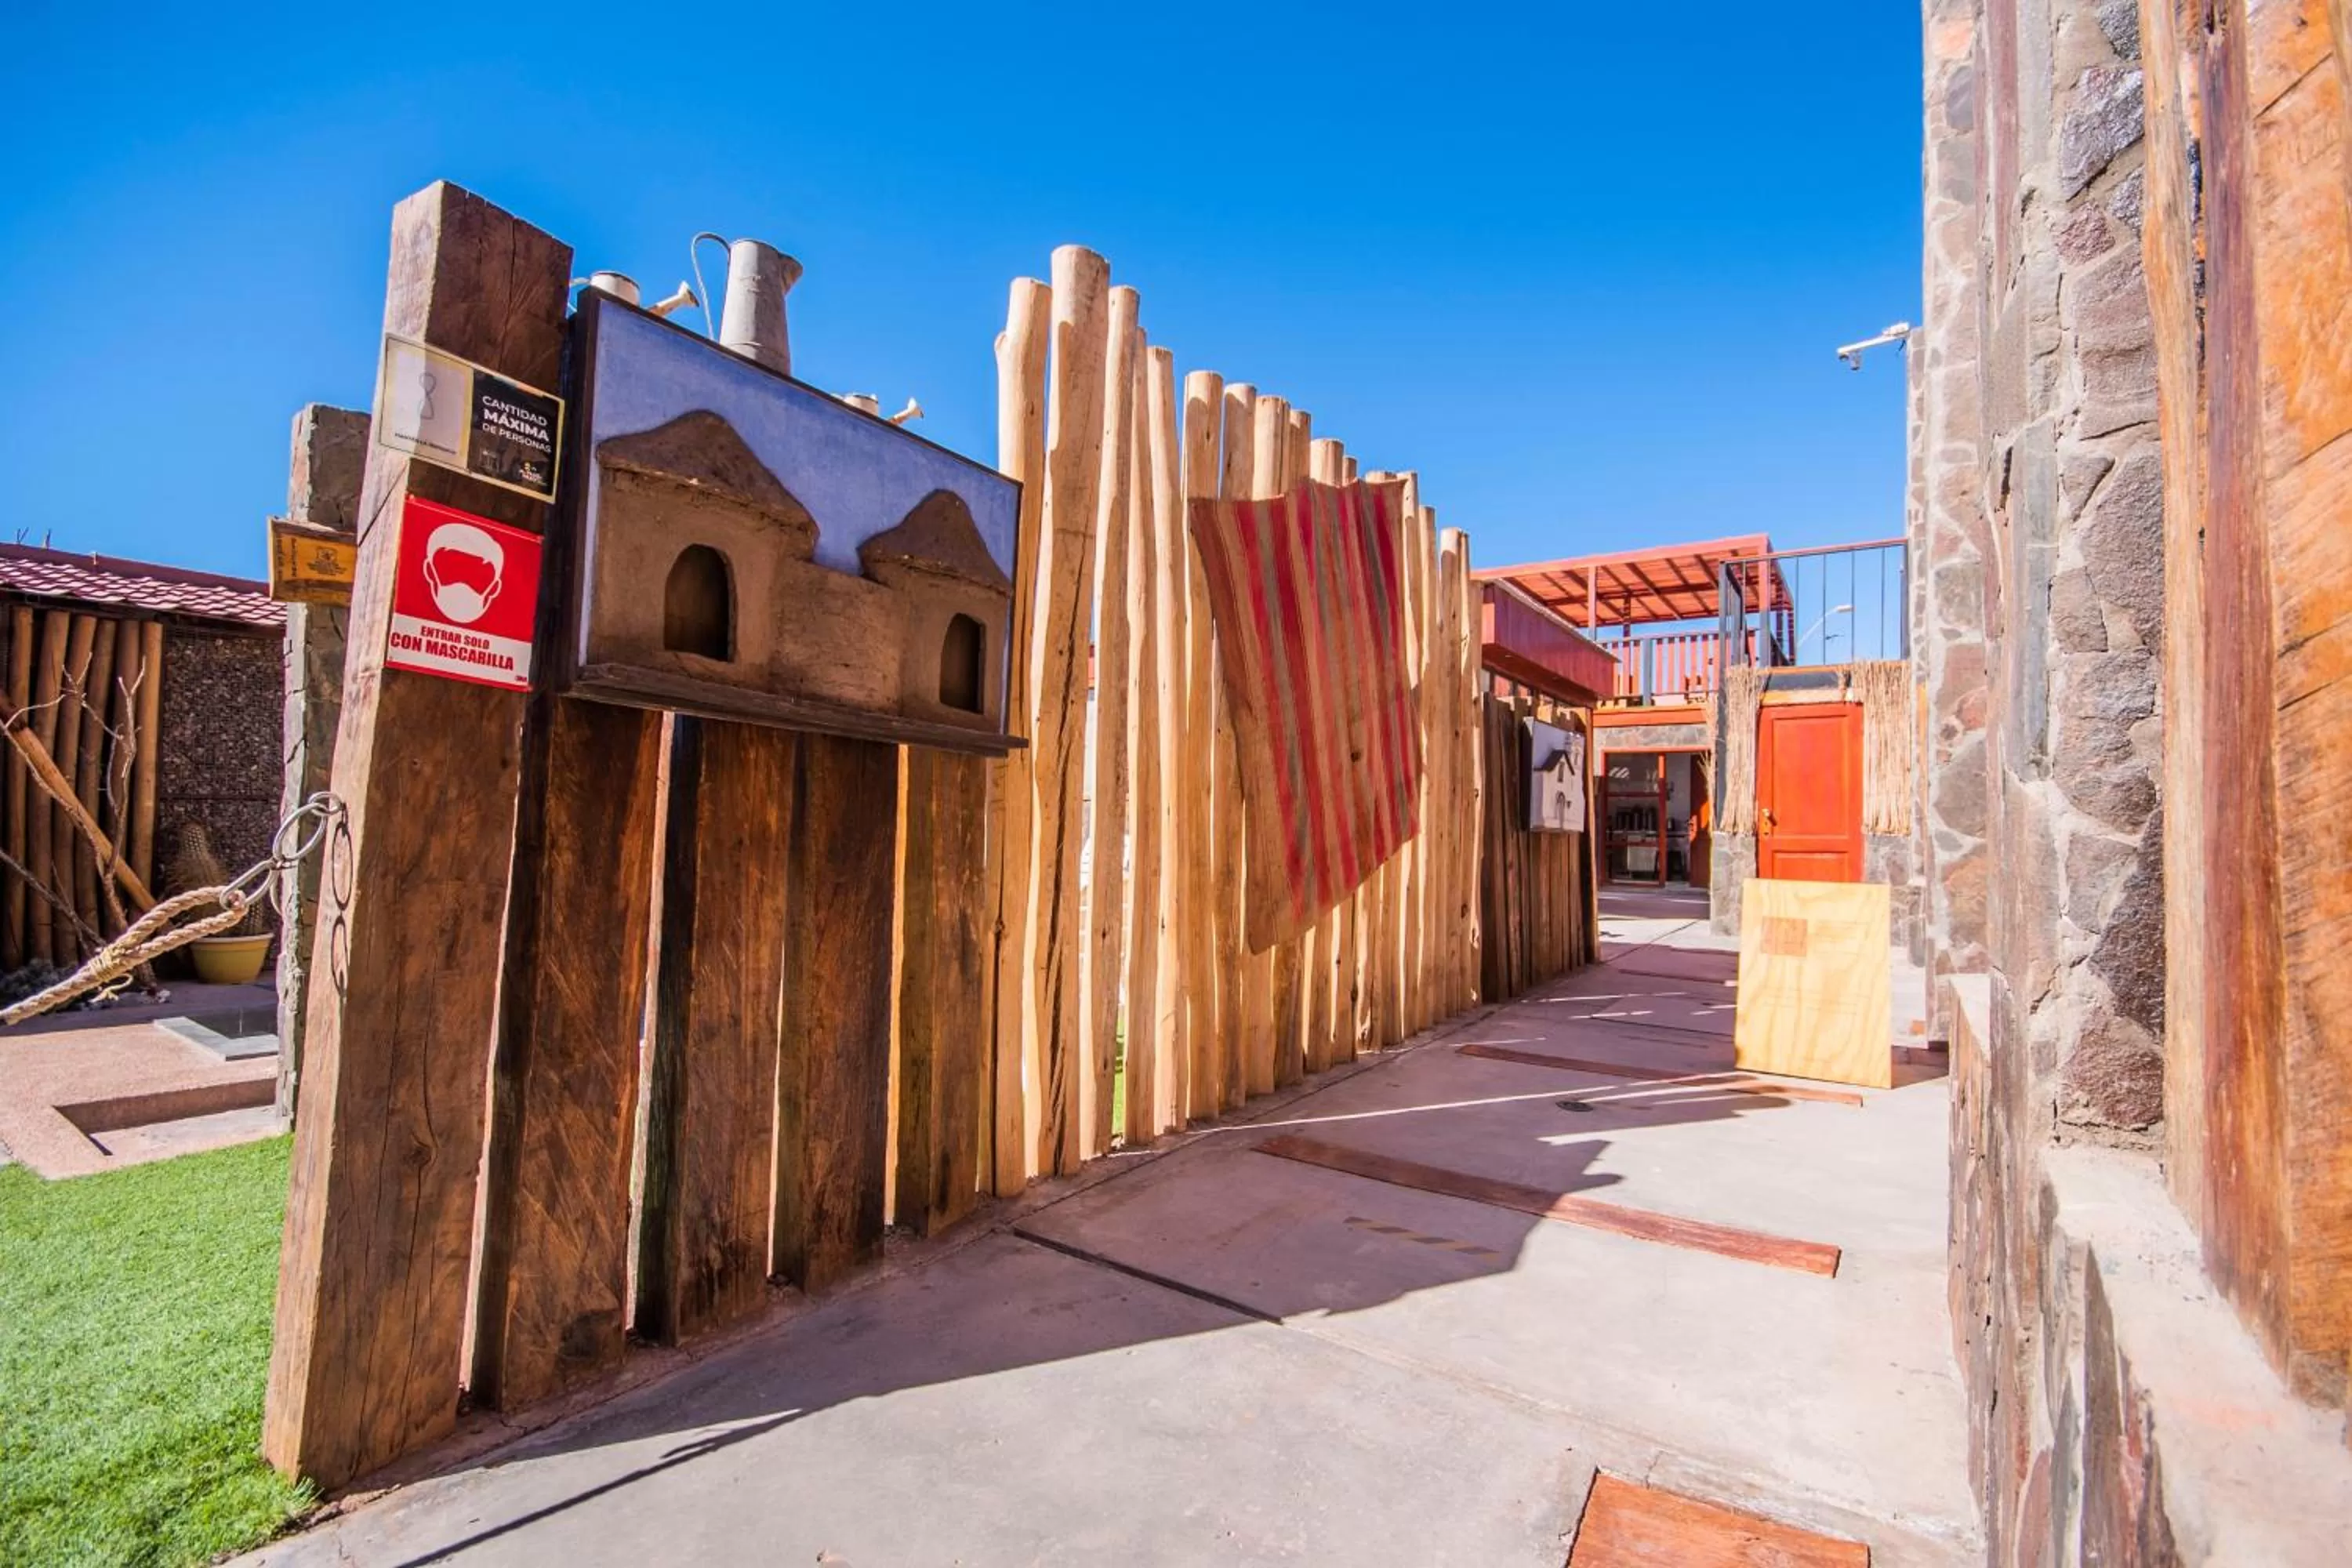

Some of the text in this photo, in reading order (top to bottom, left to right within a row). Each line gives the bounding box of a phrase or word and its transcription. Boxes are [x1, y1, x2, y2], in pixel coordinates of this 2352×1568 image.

[482, 395, 548, 426] CANTIDAD
[483, 408, 550, 441] MÁXIMA
[482, 423, 552, 453] DE PERSONAS
[390, 633, 514, 671] CON MASCARILLA
[420, 625, 490, 650] ENTRAR SOLO
